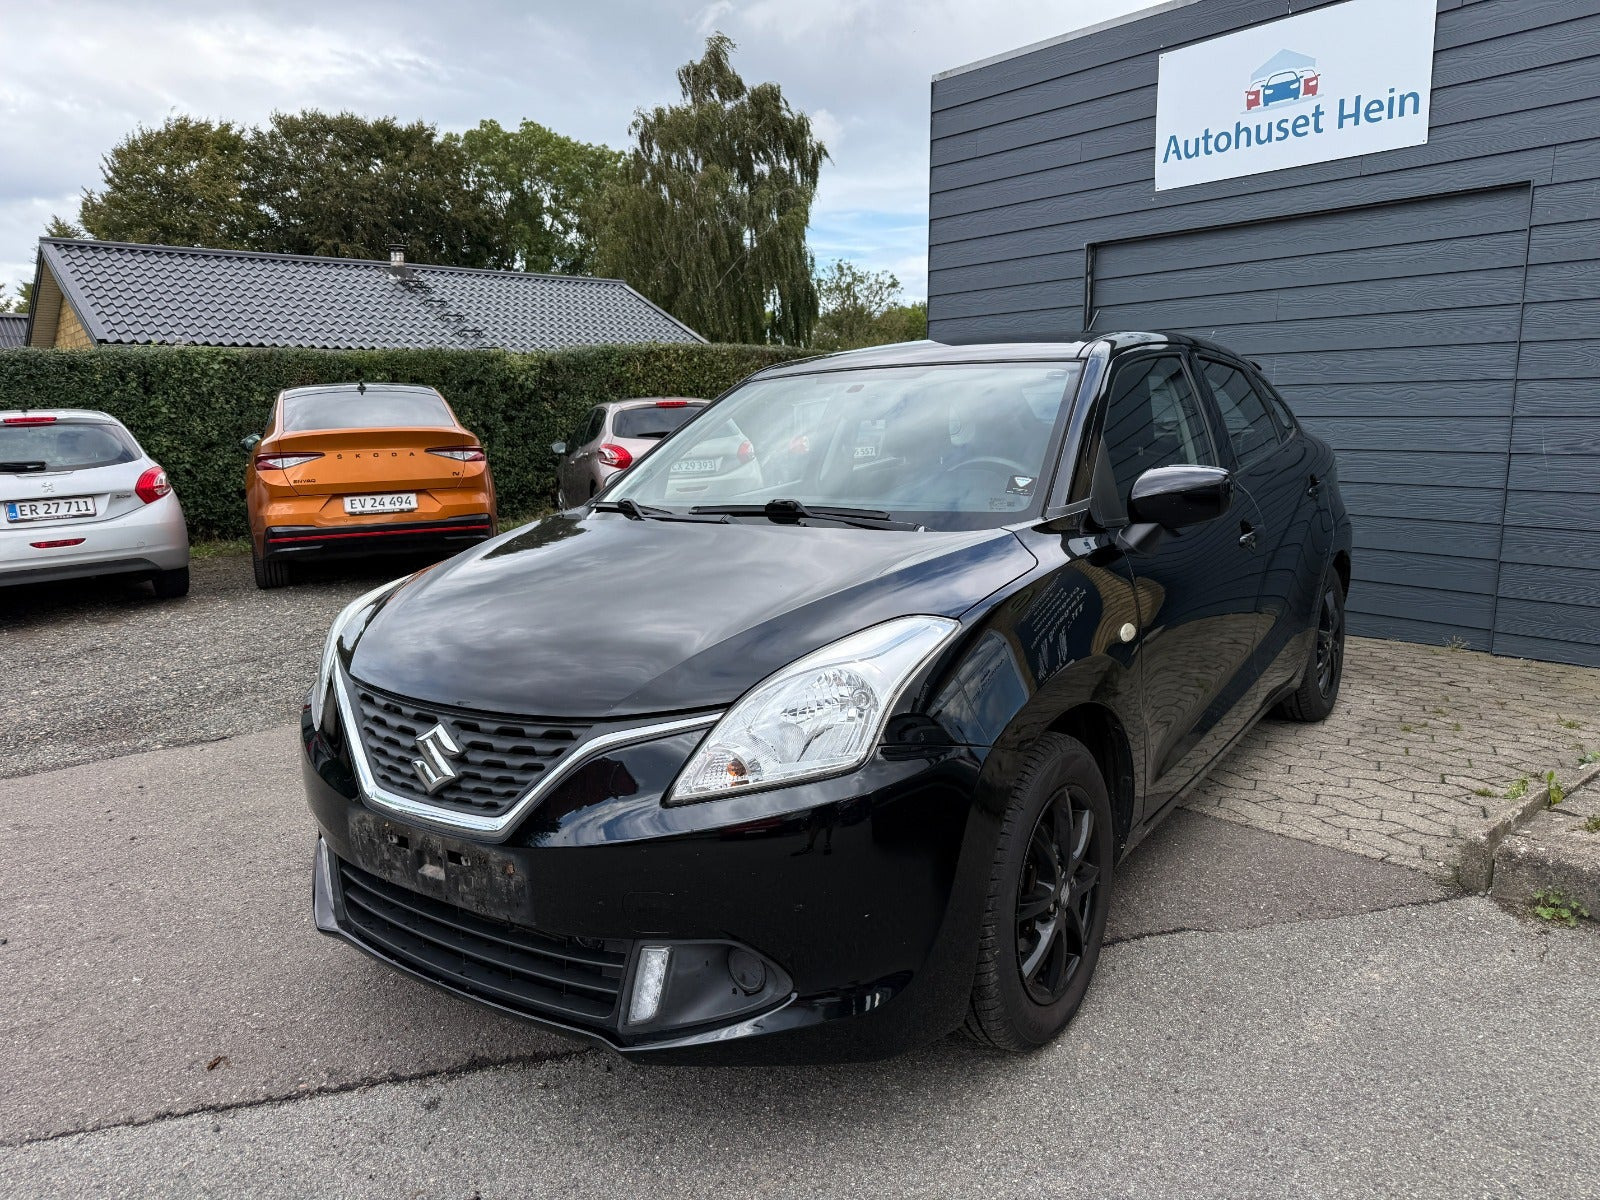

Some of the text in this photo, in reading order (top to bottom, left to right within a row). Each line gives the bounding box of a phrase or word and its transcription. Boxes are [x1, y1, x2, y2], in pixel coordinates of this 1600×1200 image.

[1162, 88, 1420, 163] Autohuset Hein
[684, 460, 696, 470] 29
[696, 459, 714, 470] 393
[18, 500, 91, 516] ER 27 711
[350, 495, 412, 509] EV 24 494
